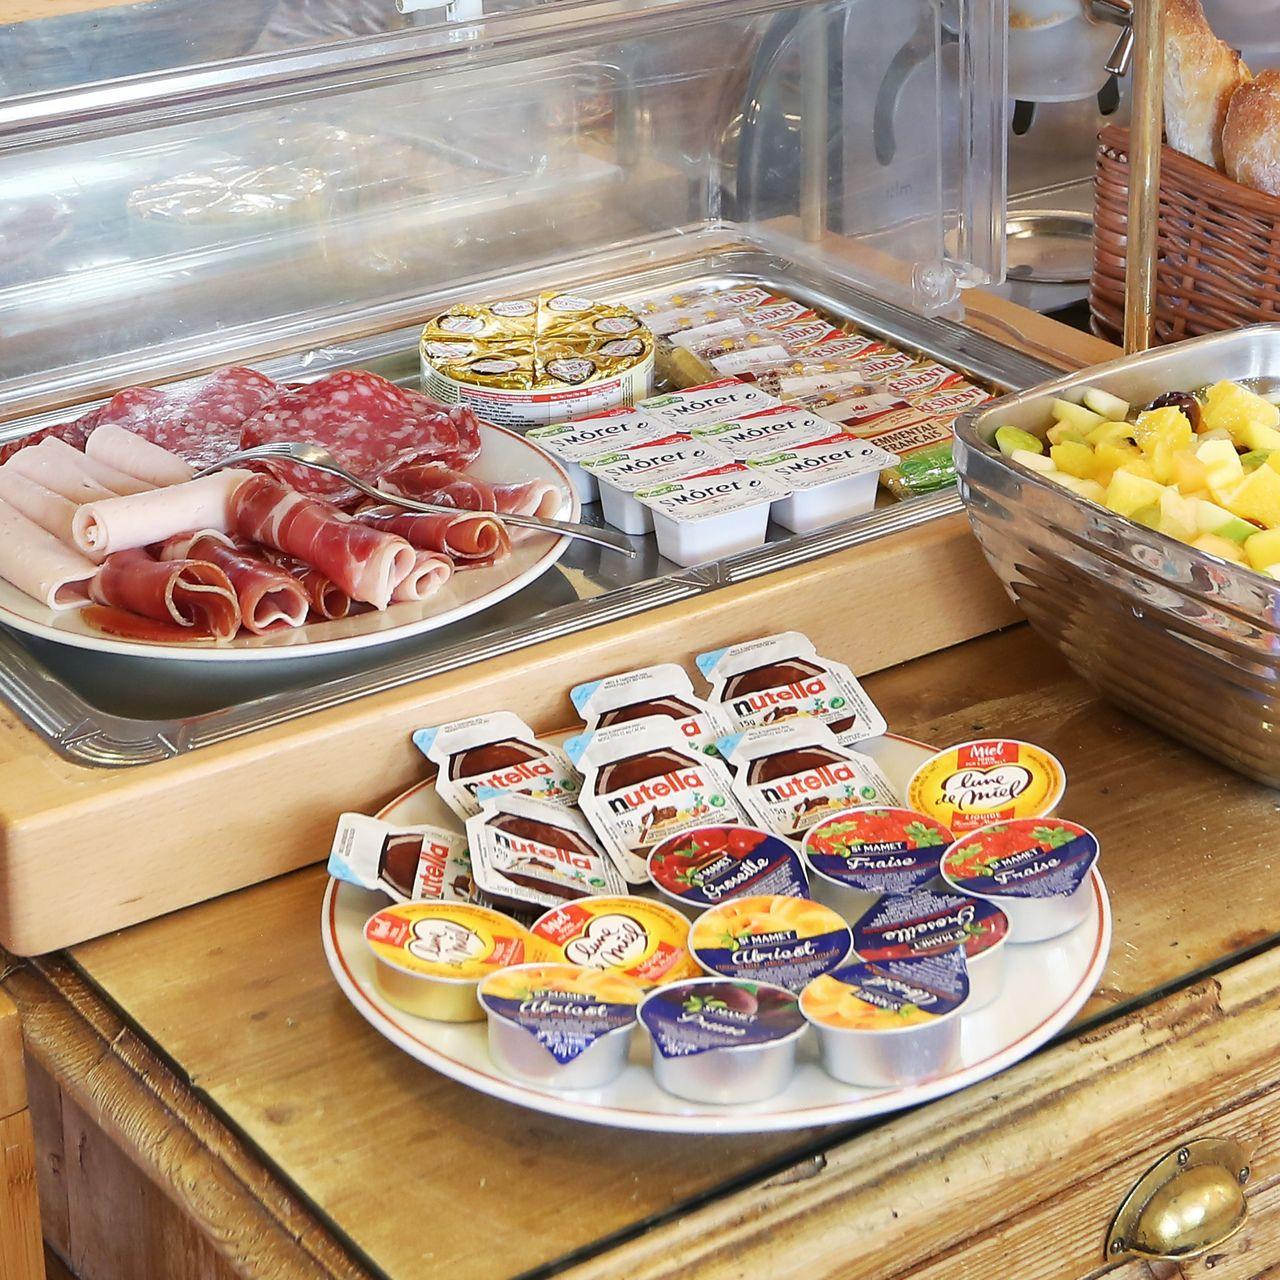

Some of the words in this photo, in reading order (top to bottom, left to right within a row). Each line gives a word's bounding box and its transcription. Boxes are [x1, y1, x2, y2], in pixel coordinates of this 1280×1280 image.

[871, 423, 938, 447] EMMENTAL
[732, 678, 826, 717] nutella
[970, 742, 1003, 758] Miel
[463, 761, 554, 797] nutella
[761, 764, 855, 802] nutella
[608, 770, 704, 814] nutella
[494, 832, 593, 871] nutella
[864, 841, 903, 852] MAMET
[999, 847, 1038, 866] MAMET
[847, 857, 916, 870] Fraise
[994, 858, 1061, 885] Fraise
[702, 856, 769, 901] Groseille
[882, 905, 975, 943] Groseille
[751, 931, 792, 944] MAMET
[913, 933, 952, 951] MAMET
[732, 941, 818, 965] Abricot
[520, 999, 608, 1017] Abricot
